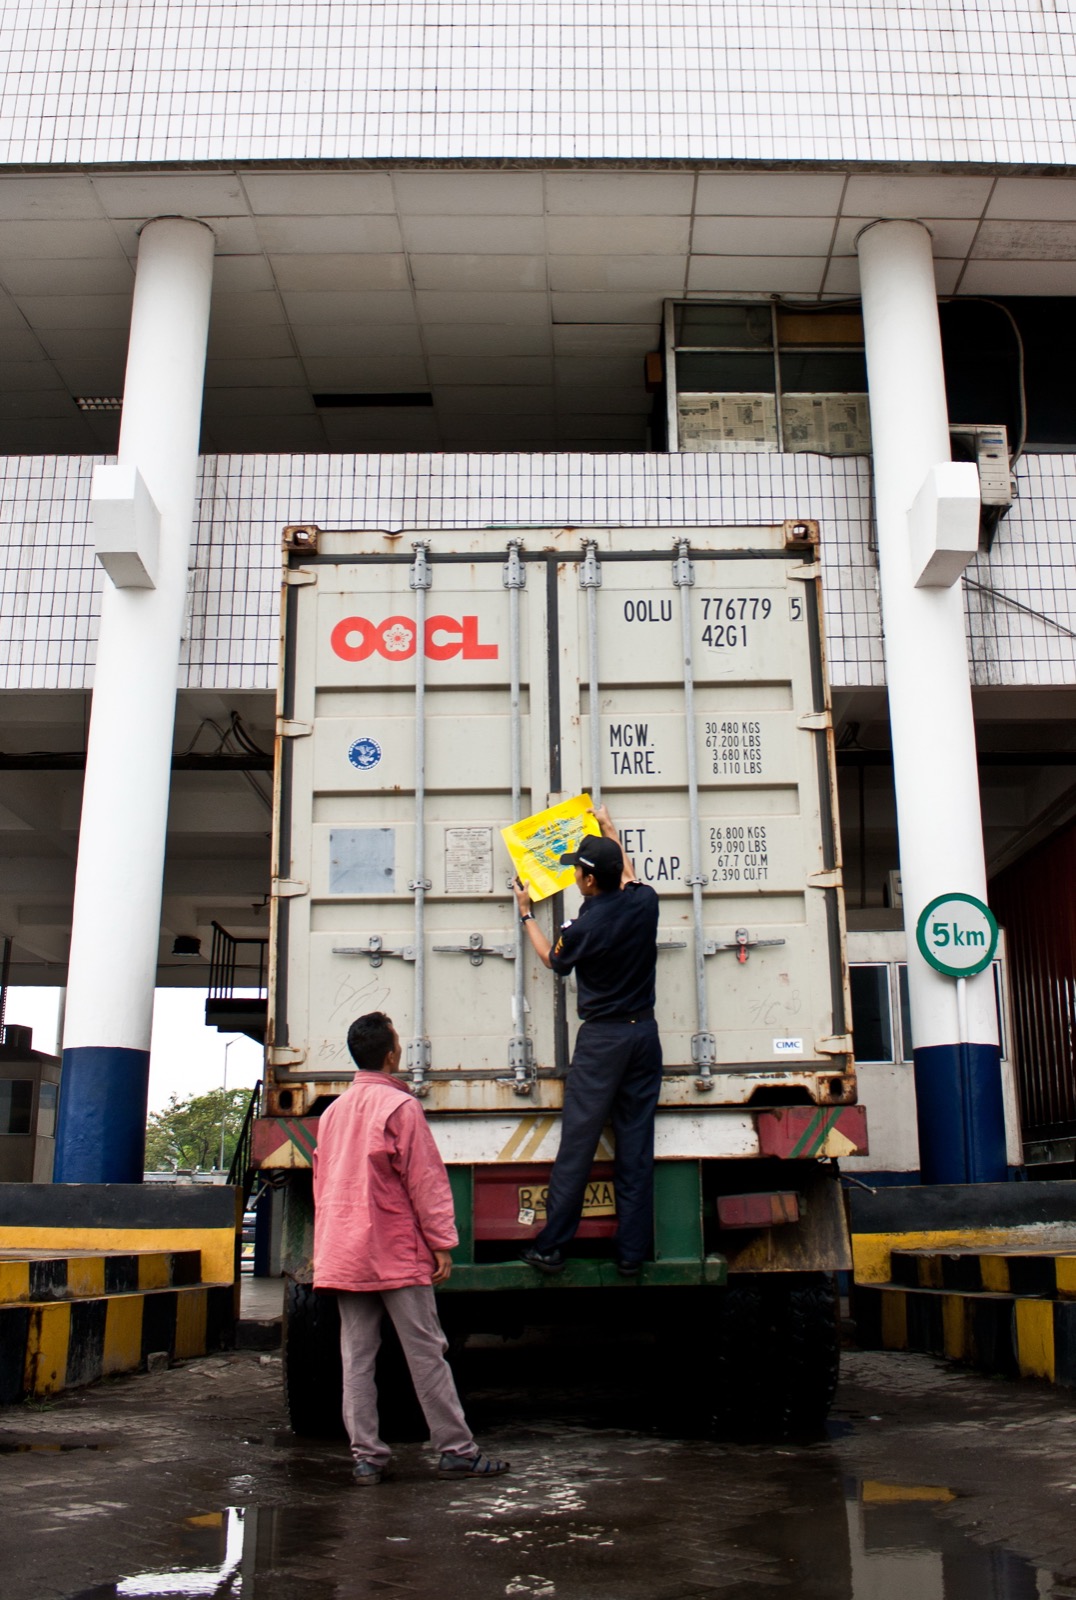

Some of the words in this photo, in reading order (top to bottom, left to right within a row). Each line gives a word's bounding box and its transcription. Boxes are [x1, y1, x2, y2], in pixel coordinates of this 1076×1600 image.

[700, 598, 772, 620] 776779
[791, 599, 801, 620] 5
[330, 615, 498, 662] OOCL
[701, 625, 747, 647] 42G1
[705, 722, 739, 734] 30.480
[742, 722, 760, 734] KGS
[609, 724, 655, 747] MGW.
[705, 736, 739, 747] 67.200
[742, 735, 761, 747] LBS
[712, 749, 740, 761] 3.680
[743, 749, 761, 761] KGS
[611, 751, 662, 775] TARE.
[712, 762, 741, 774] 8.110
[743, 762, 762, 774] LBS
[709, 827, 744, 840] 26.800
[748, 826, 766, 839] KGS
[710, 841, 745, 853] 59.090
[748, 840, 767, 853] LBS
[717, 855, 739, 867] 67.7
[744, 854, 768, 866] CU.M
[711, 869, 740, 881] 2.390
[743, 868, 768, 880] CU.FT
[775, 1041, 800, 1049] CIMC
